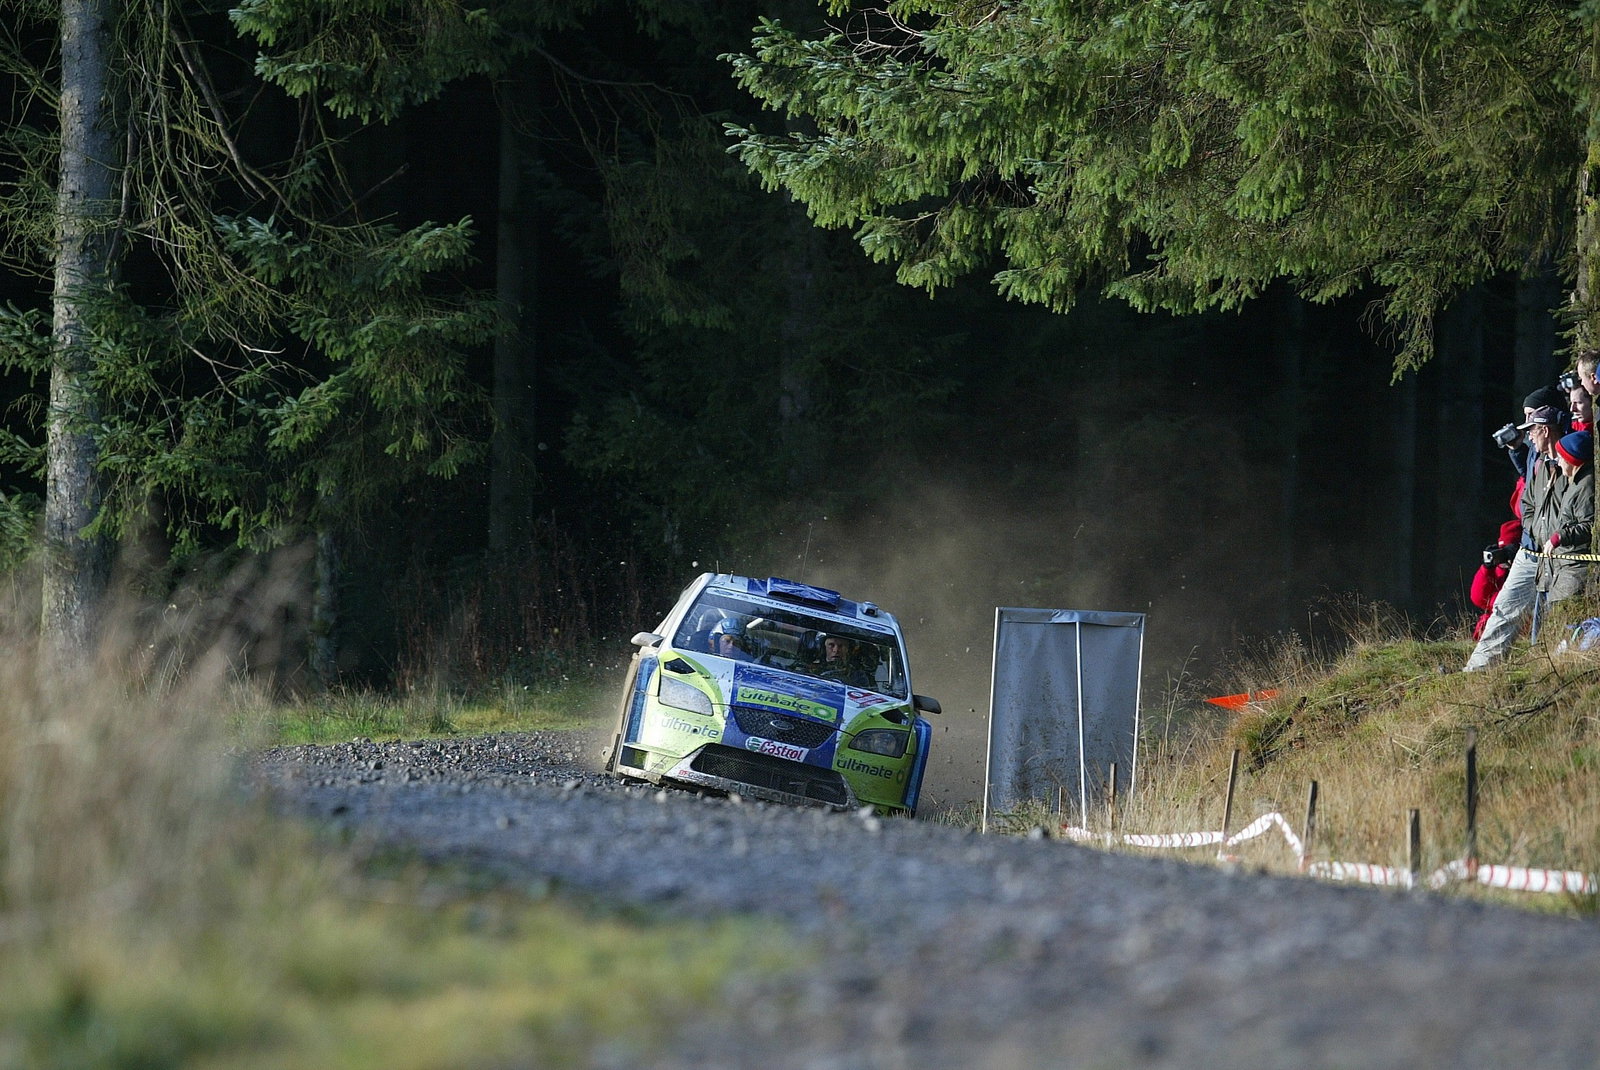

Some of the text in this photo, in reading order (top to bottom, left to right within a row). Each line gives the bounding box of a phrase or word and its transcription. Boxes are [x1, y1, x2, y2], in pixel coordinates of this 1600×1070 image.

[741, 691, 810, 711] ultimate
[661, 717, 719, 739] ultimate
[760, 740, 804, 761] Castrol
[836, 757, 893, 779] ultimate
